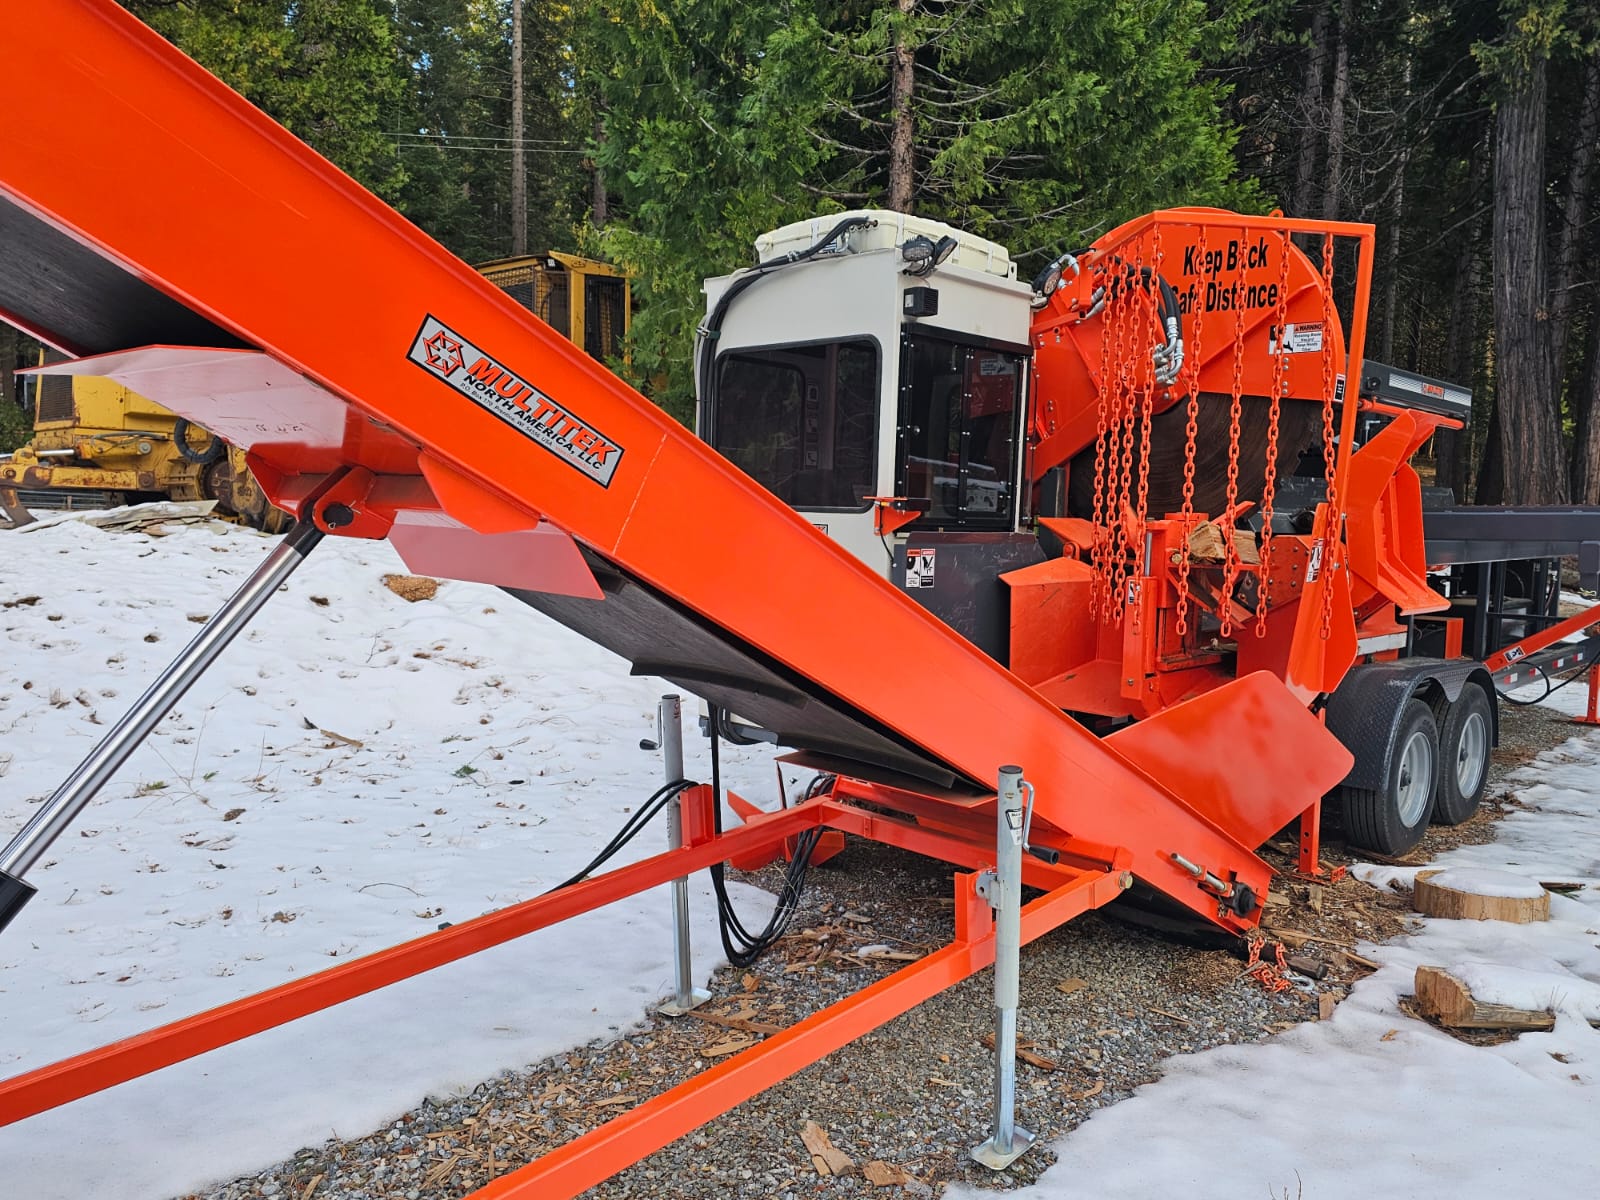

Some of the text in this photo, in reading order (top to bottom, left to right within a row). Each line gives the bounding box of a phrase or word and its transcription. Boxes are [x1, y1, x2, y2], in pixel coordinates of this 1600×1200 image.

[1226, 237, 1269, 271] Bck
[1205, 280, 1278, 312] Distnce
[463, 375, 515, 411] NORTH
[514, 410, 575, 454] AMERICA,
[577, 451, 602, 469] LLC
[467, 357, 618, 465] MULTITEK
